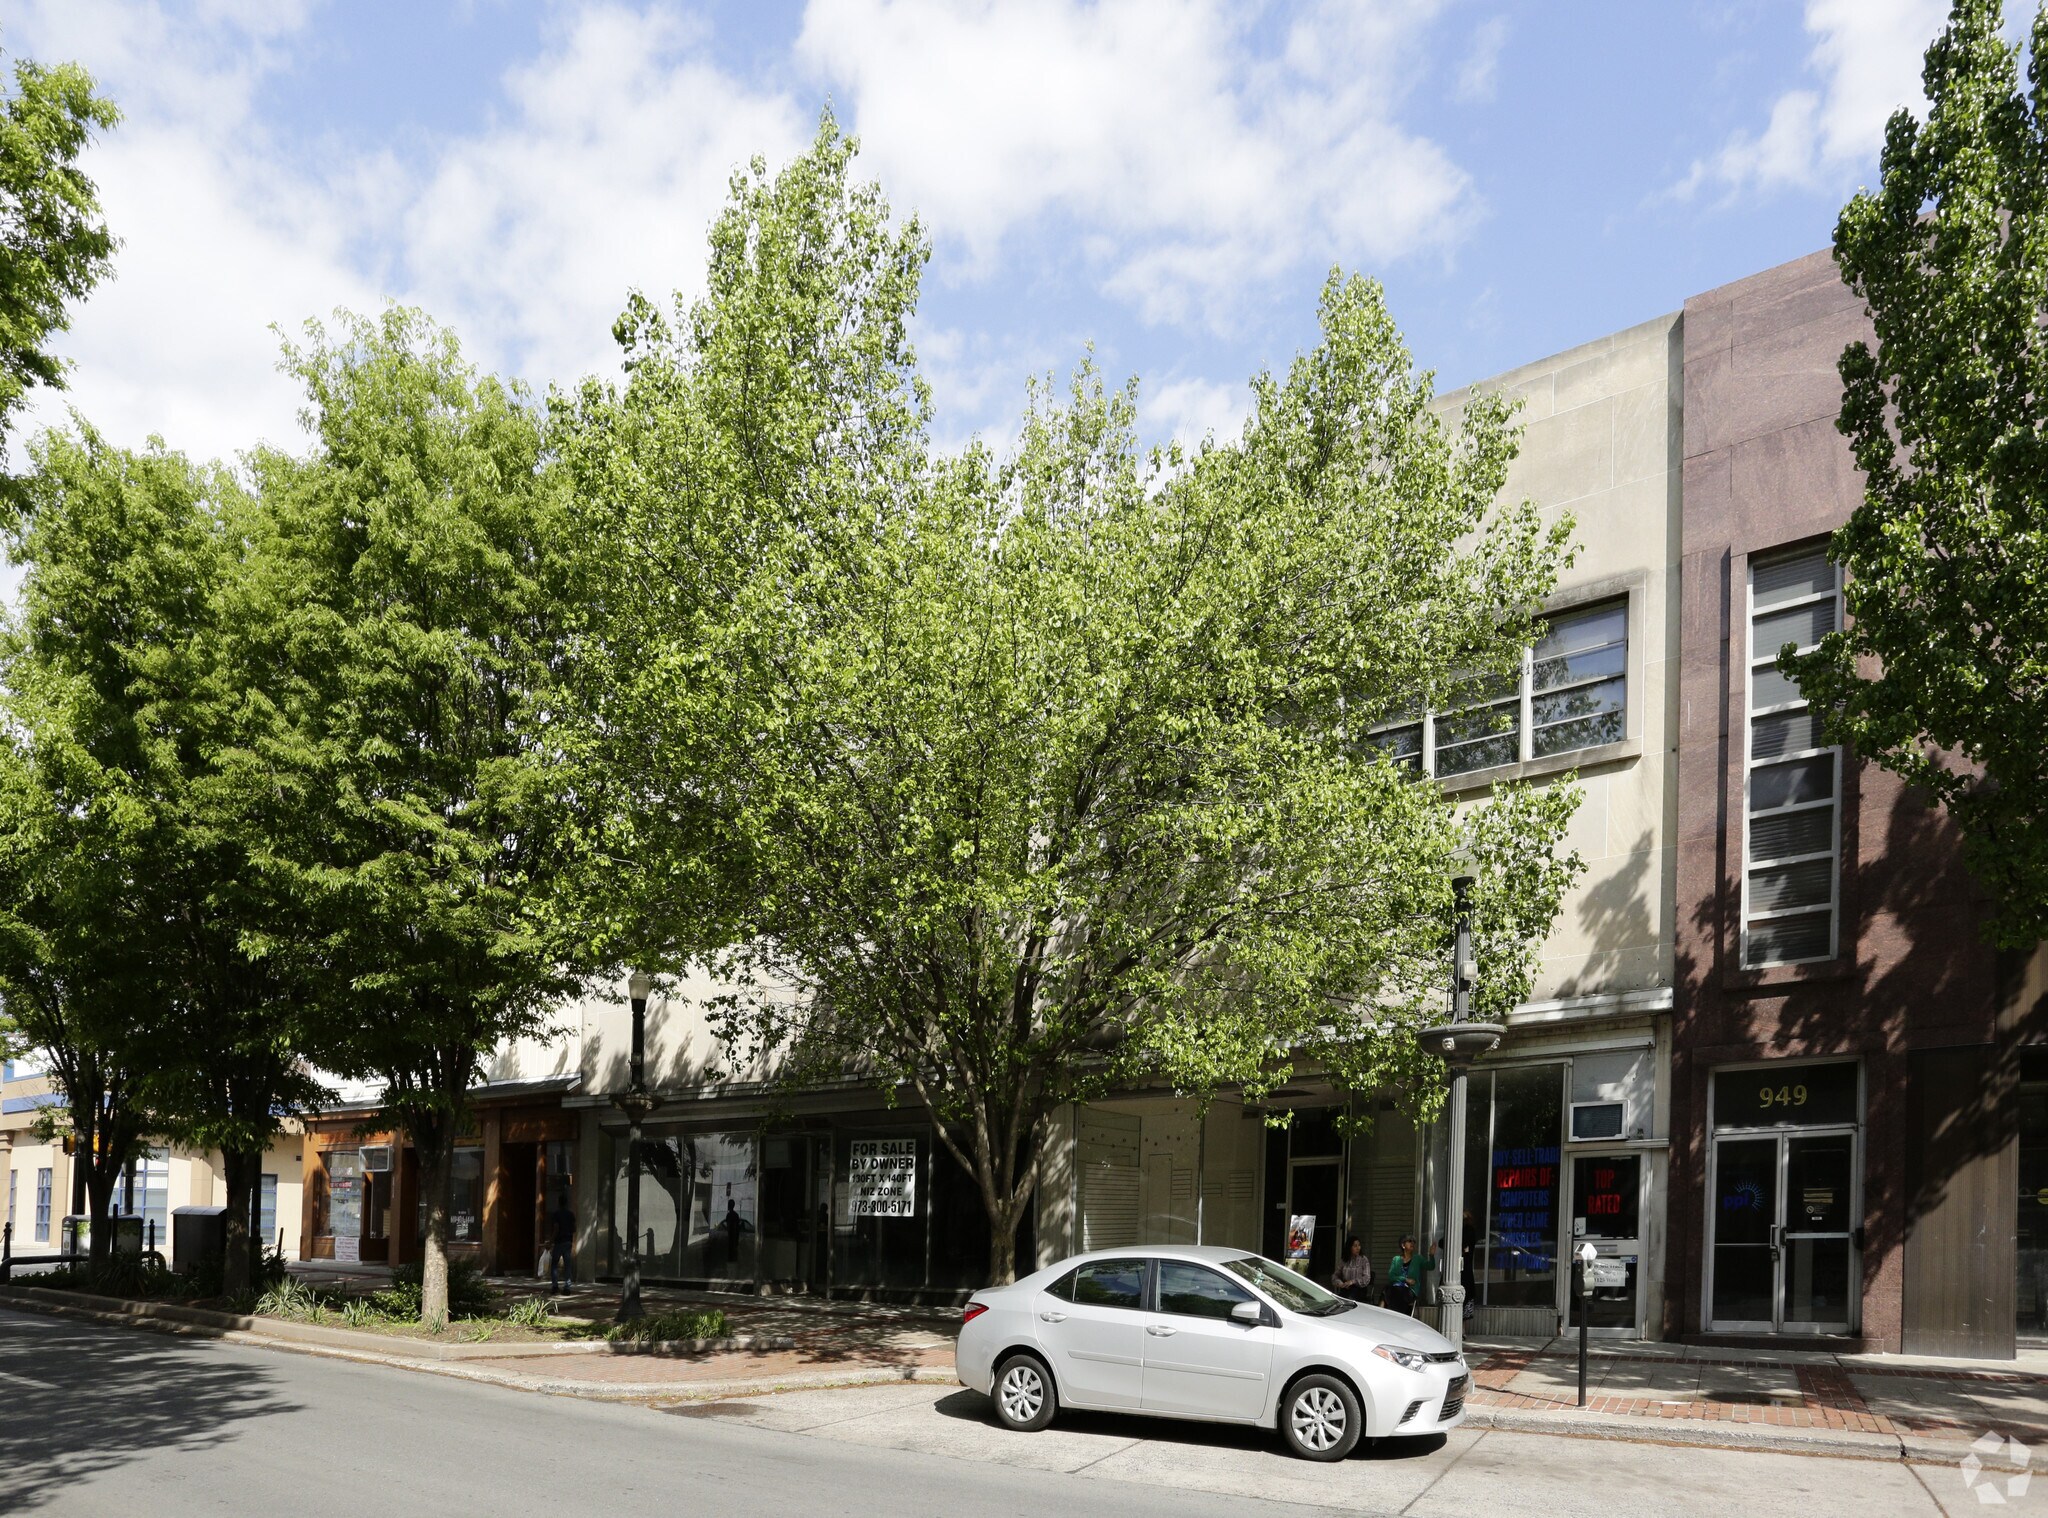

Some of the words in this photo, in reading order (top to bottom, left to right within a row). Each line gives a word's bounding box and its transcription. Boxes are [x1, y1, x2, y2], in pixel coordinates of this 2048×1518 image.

[1759, 1084, 1808, 1109] 949
[853, 1143, 877, 1155] FOR
[881, 1142, 914, 1154] SALE
[852, 1158, 867, 1169] BY
[871, 1158, 913, 1169] OWNER
[852, 1174, 876, 1183] 130FT
[879, 1174, 885, 1182] X
[887, 1174, 912, 1182] 140FT
[1497, 1167, 1537, 1188] REPAIRS
[1594, 1168, 1615, 1189] TOP
[860, 1187, 875, 1196] NIZ
[877, 1187, 903, 1196] ZONE
[1499, 1190, 1550, 1207] COMPUTERS
[1587, 1193, 1621, 1215] RATED
[1499, 1212, 1524, 1229] VIDEO
[1525, 1211, 1550, 1228] GAME
